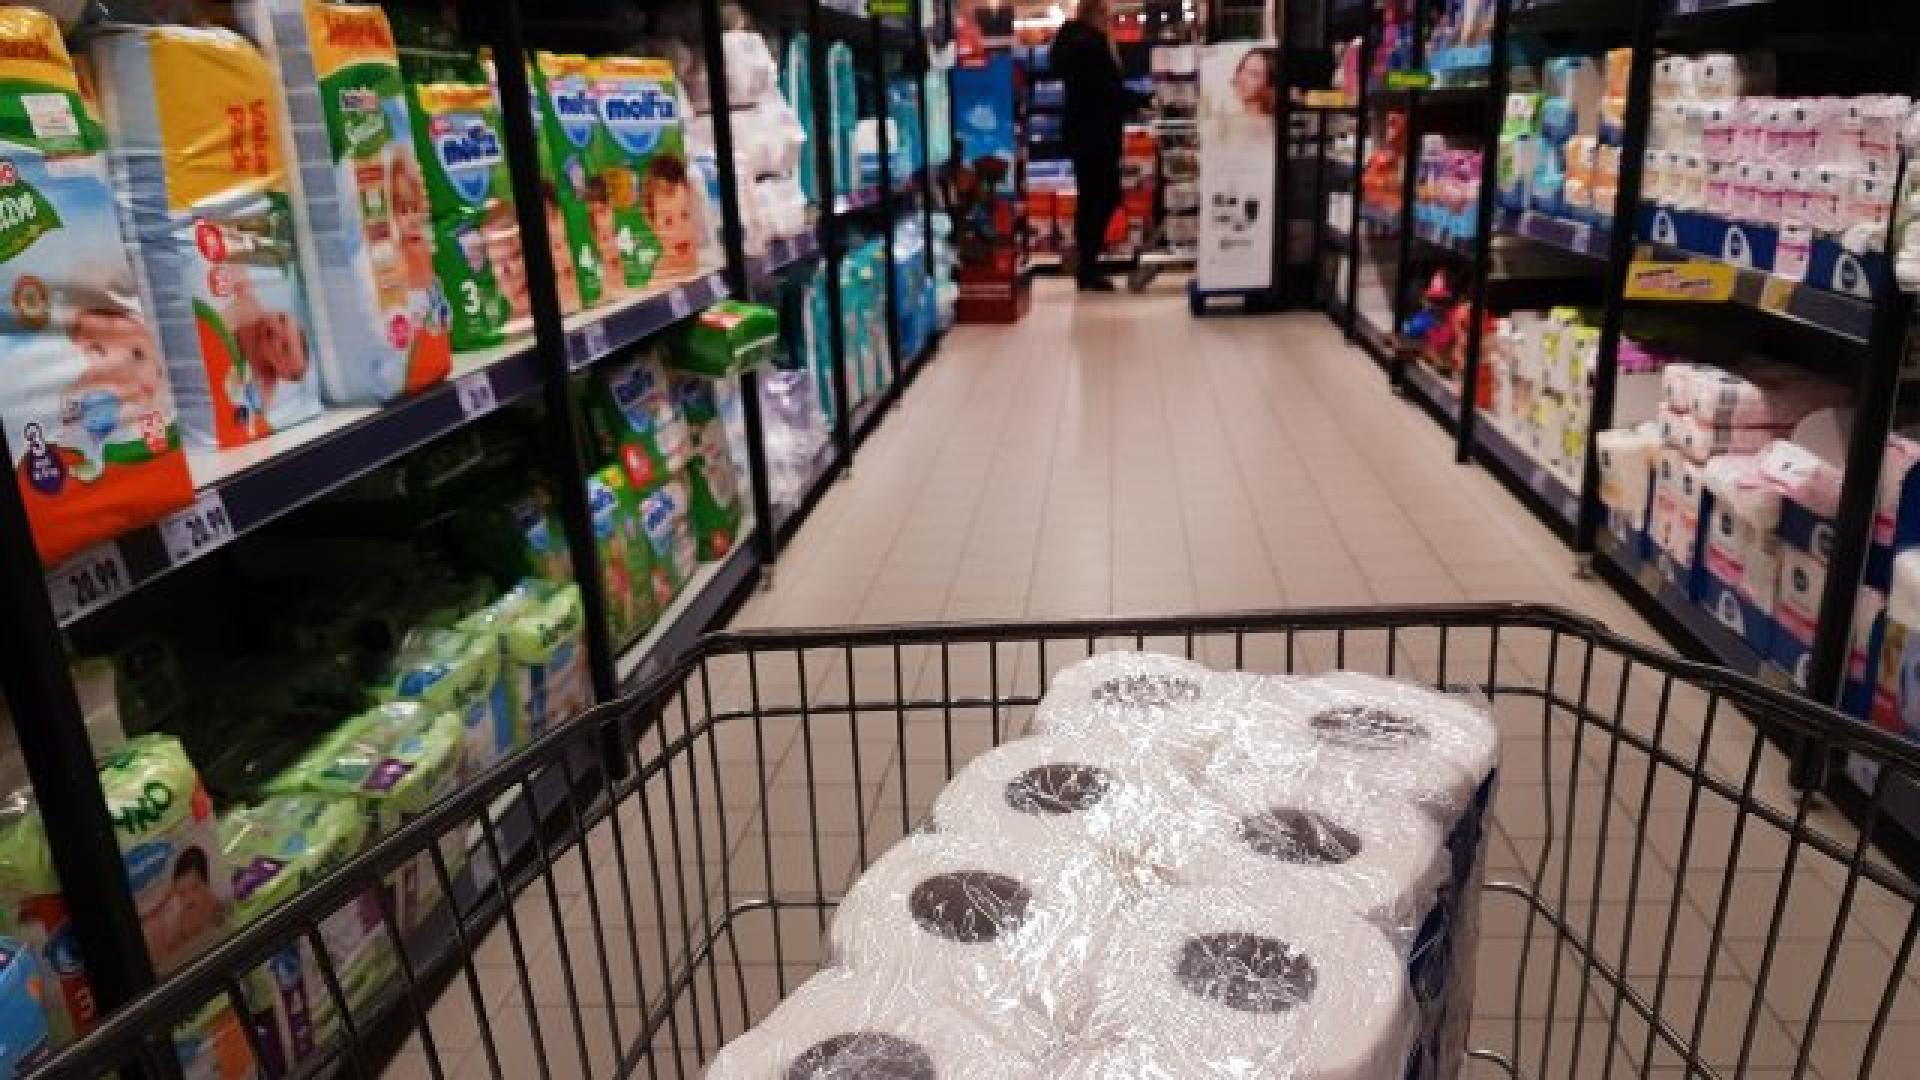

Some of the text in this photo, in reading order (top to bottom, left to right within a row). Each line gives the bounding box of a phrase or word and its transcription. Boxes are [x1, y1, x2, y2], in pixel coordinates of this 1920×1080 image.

[460, 279, 481, 314] 3
[186, 506, 227, 548] 20.99
[69, 558, 119, 608] 20.99
